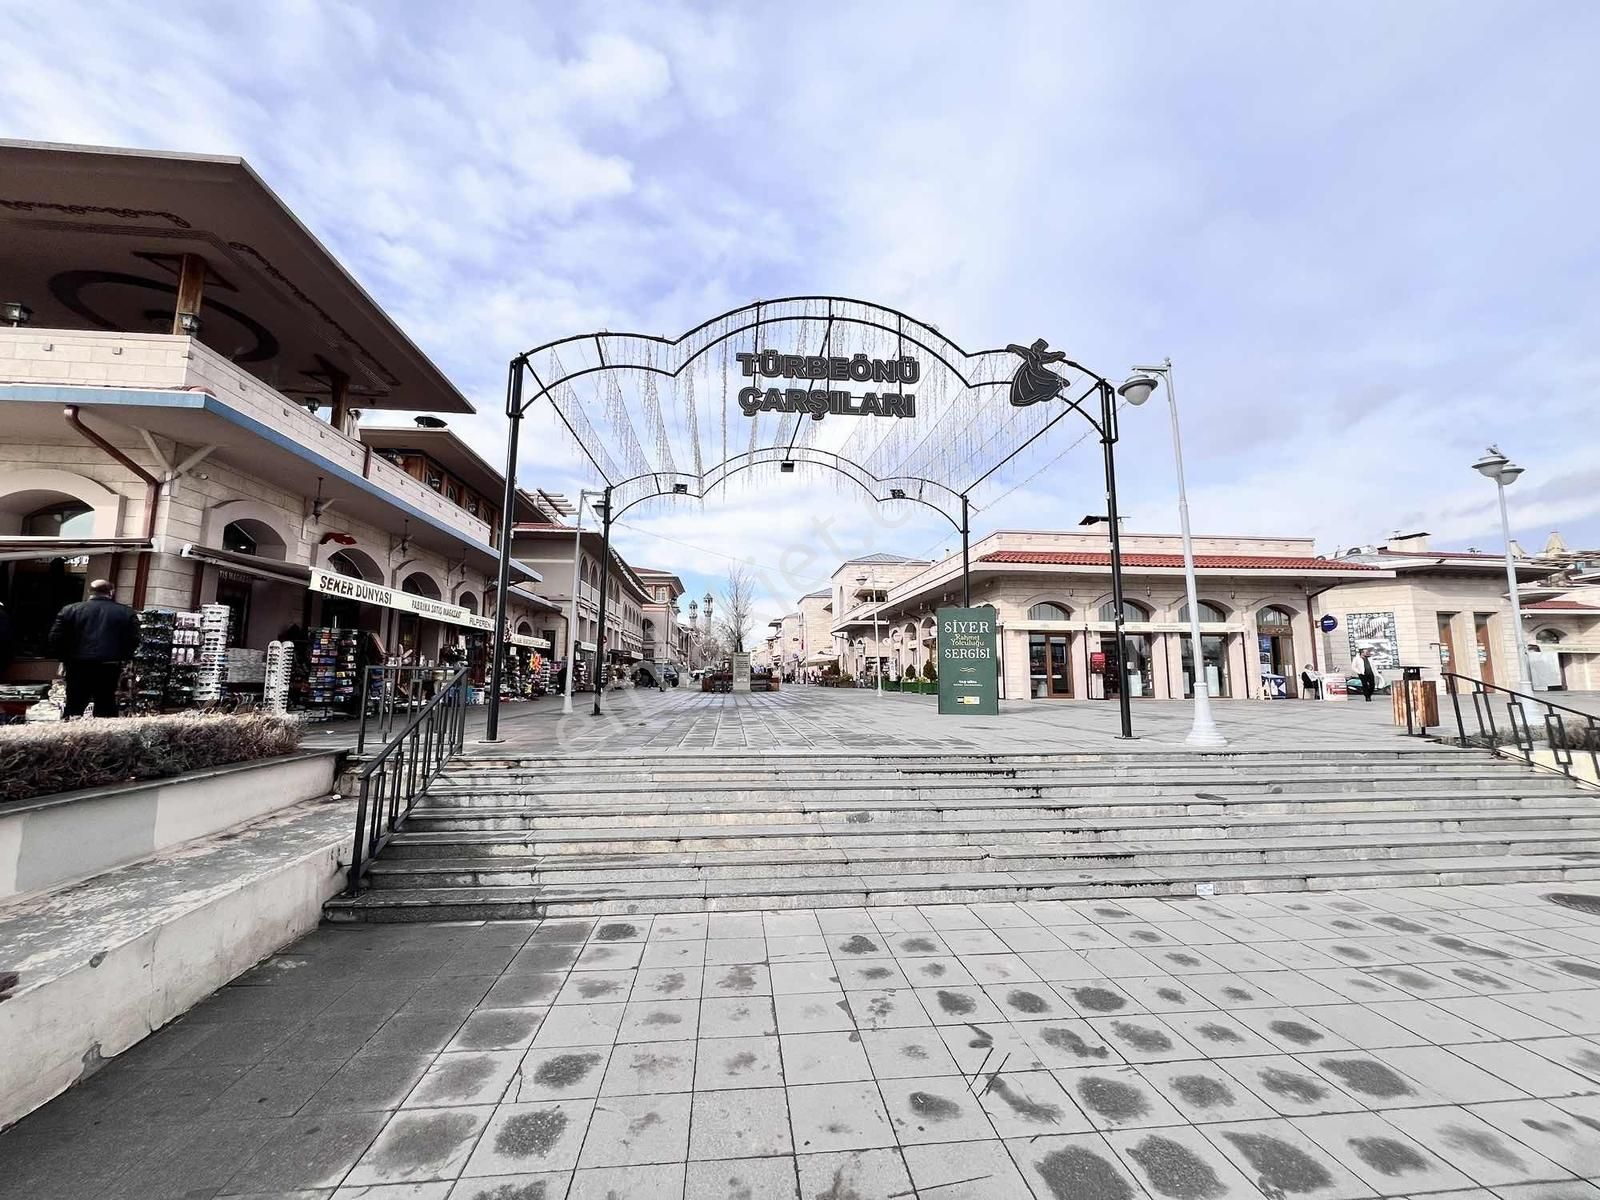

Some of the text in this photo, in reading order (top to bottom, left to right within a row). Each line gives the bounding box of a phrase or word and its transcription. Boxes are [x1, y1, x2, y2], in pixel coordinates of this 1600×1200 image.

[736, 350, 920, 384] TÜRBEÖNÜ
[738, 387, 916, 420] ÇARŞILARI
[320, 575, 354, 592] ŞEKER
[945, 620, 989, 633] SİYER
[944, 647, 990, 659] SERGİSİ
